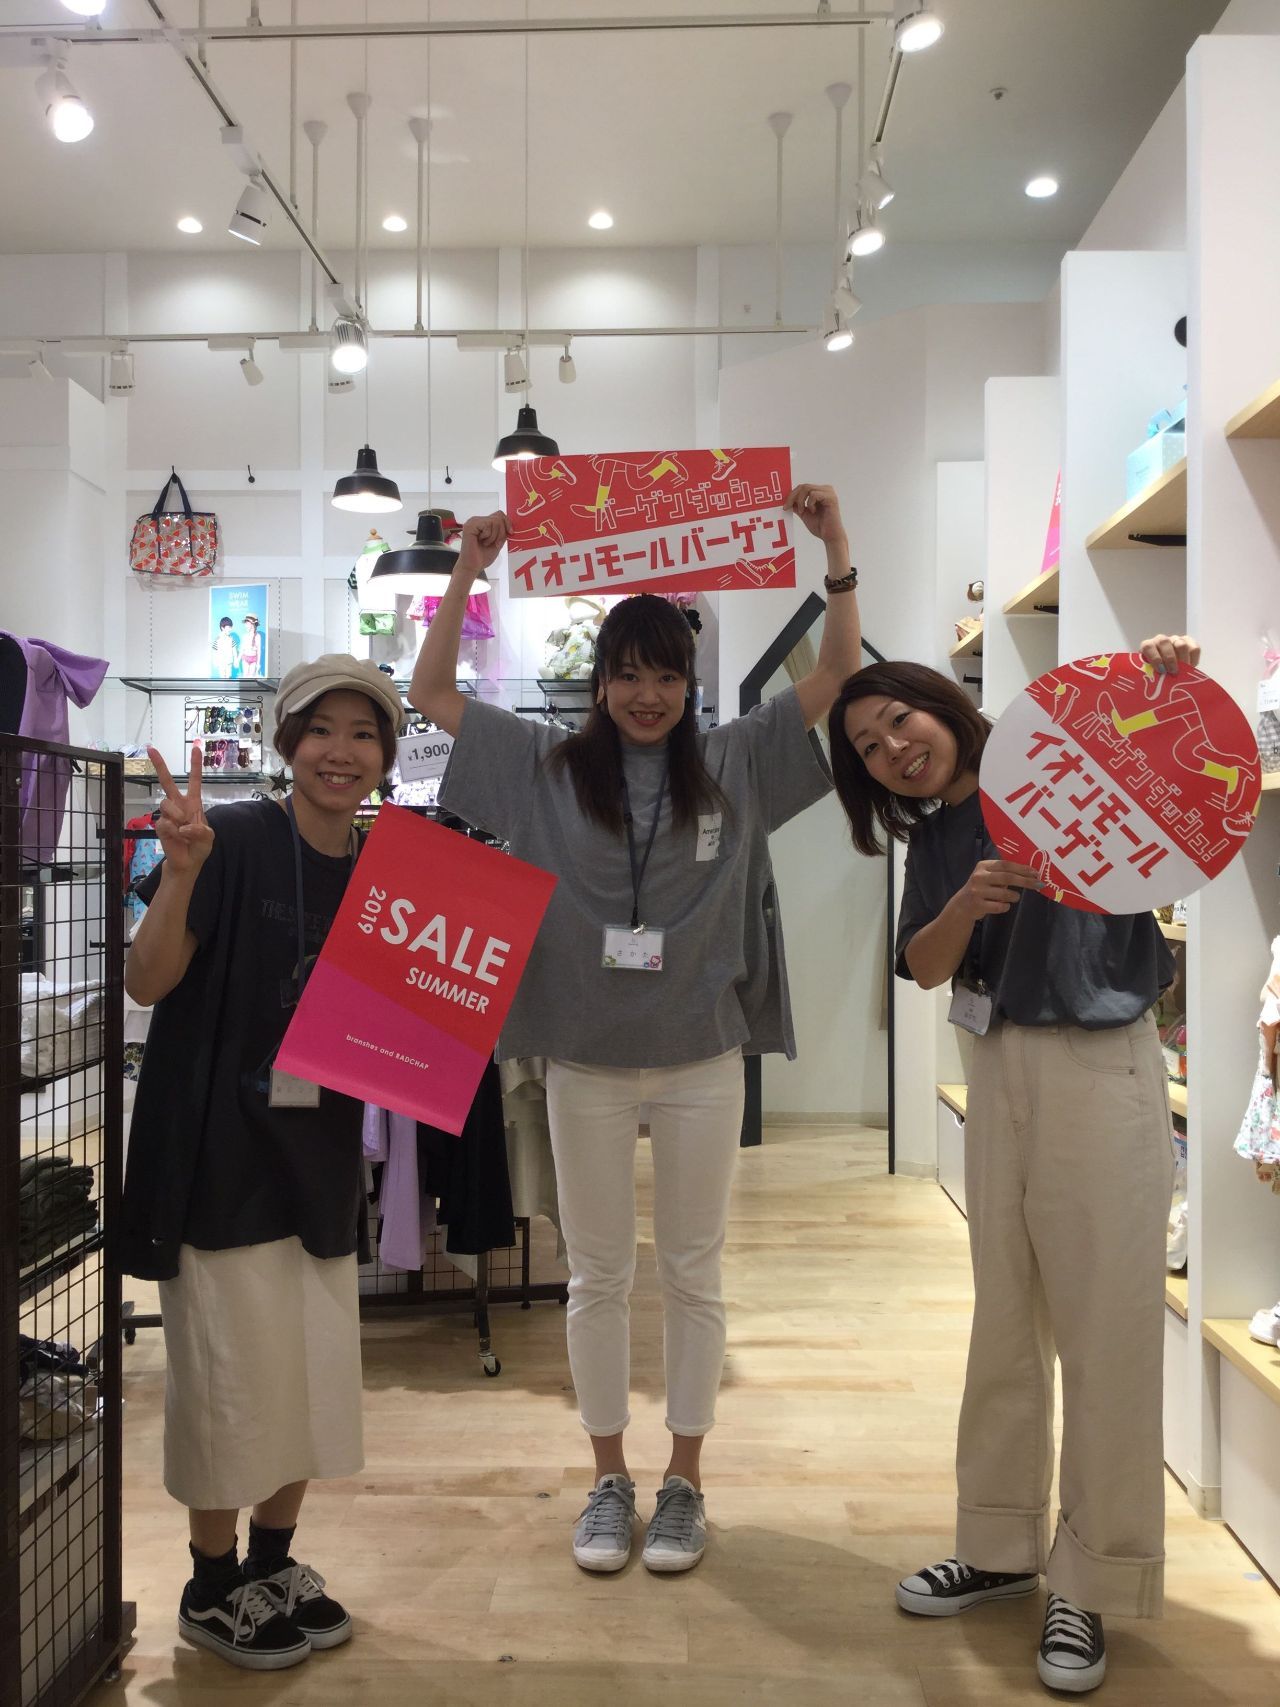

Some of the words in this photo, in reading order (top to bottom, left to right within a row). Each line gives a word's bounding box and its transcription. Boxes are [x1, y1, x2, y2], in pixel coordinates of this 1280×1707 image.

[514, 517, 789, 591] イオンモールバーゲン
[1005, 781, 1114, 887] バーゲン
[1026, 731, 1169, 879] イオンモール
[357, 885, 387, 935] 2019
[380, 898, 511, 986] SALE
[405, 967, 490, 1015] SUMMER
[379, 1046, 394, 1058] and
